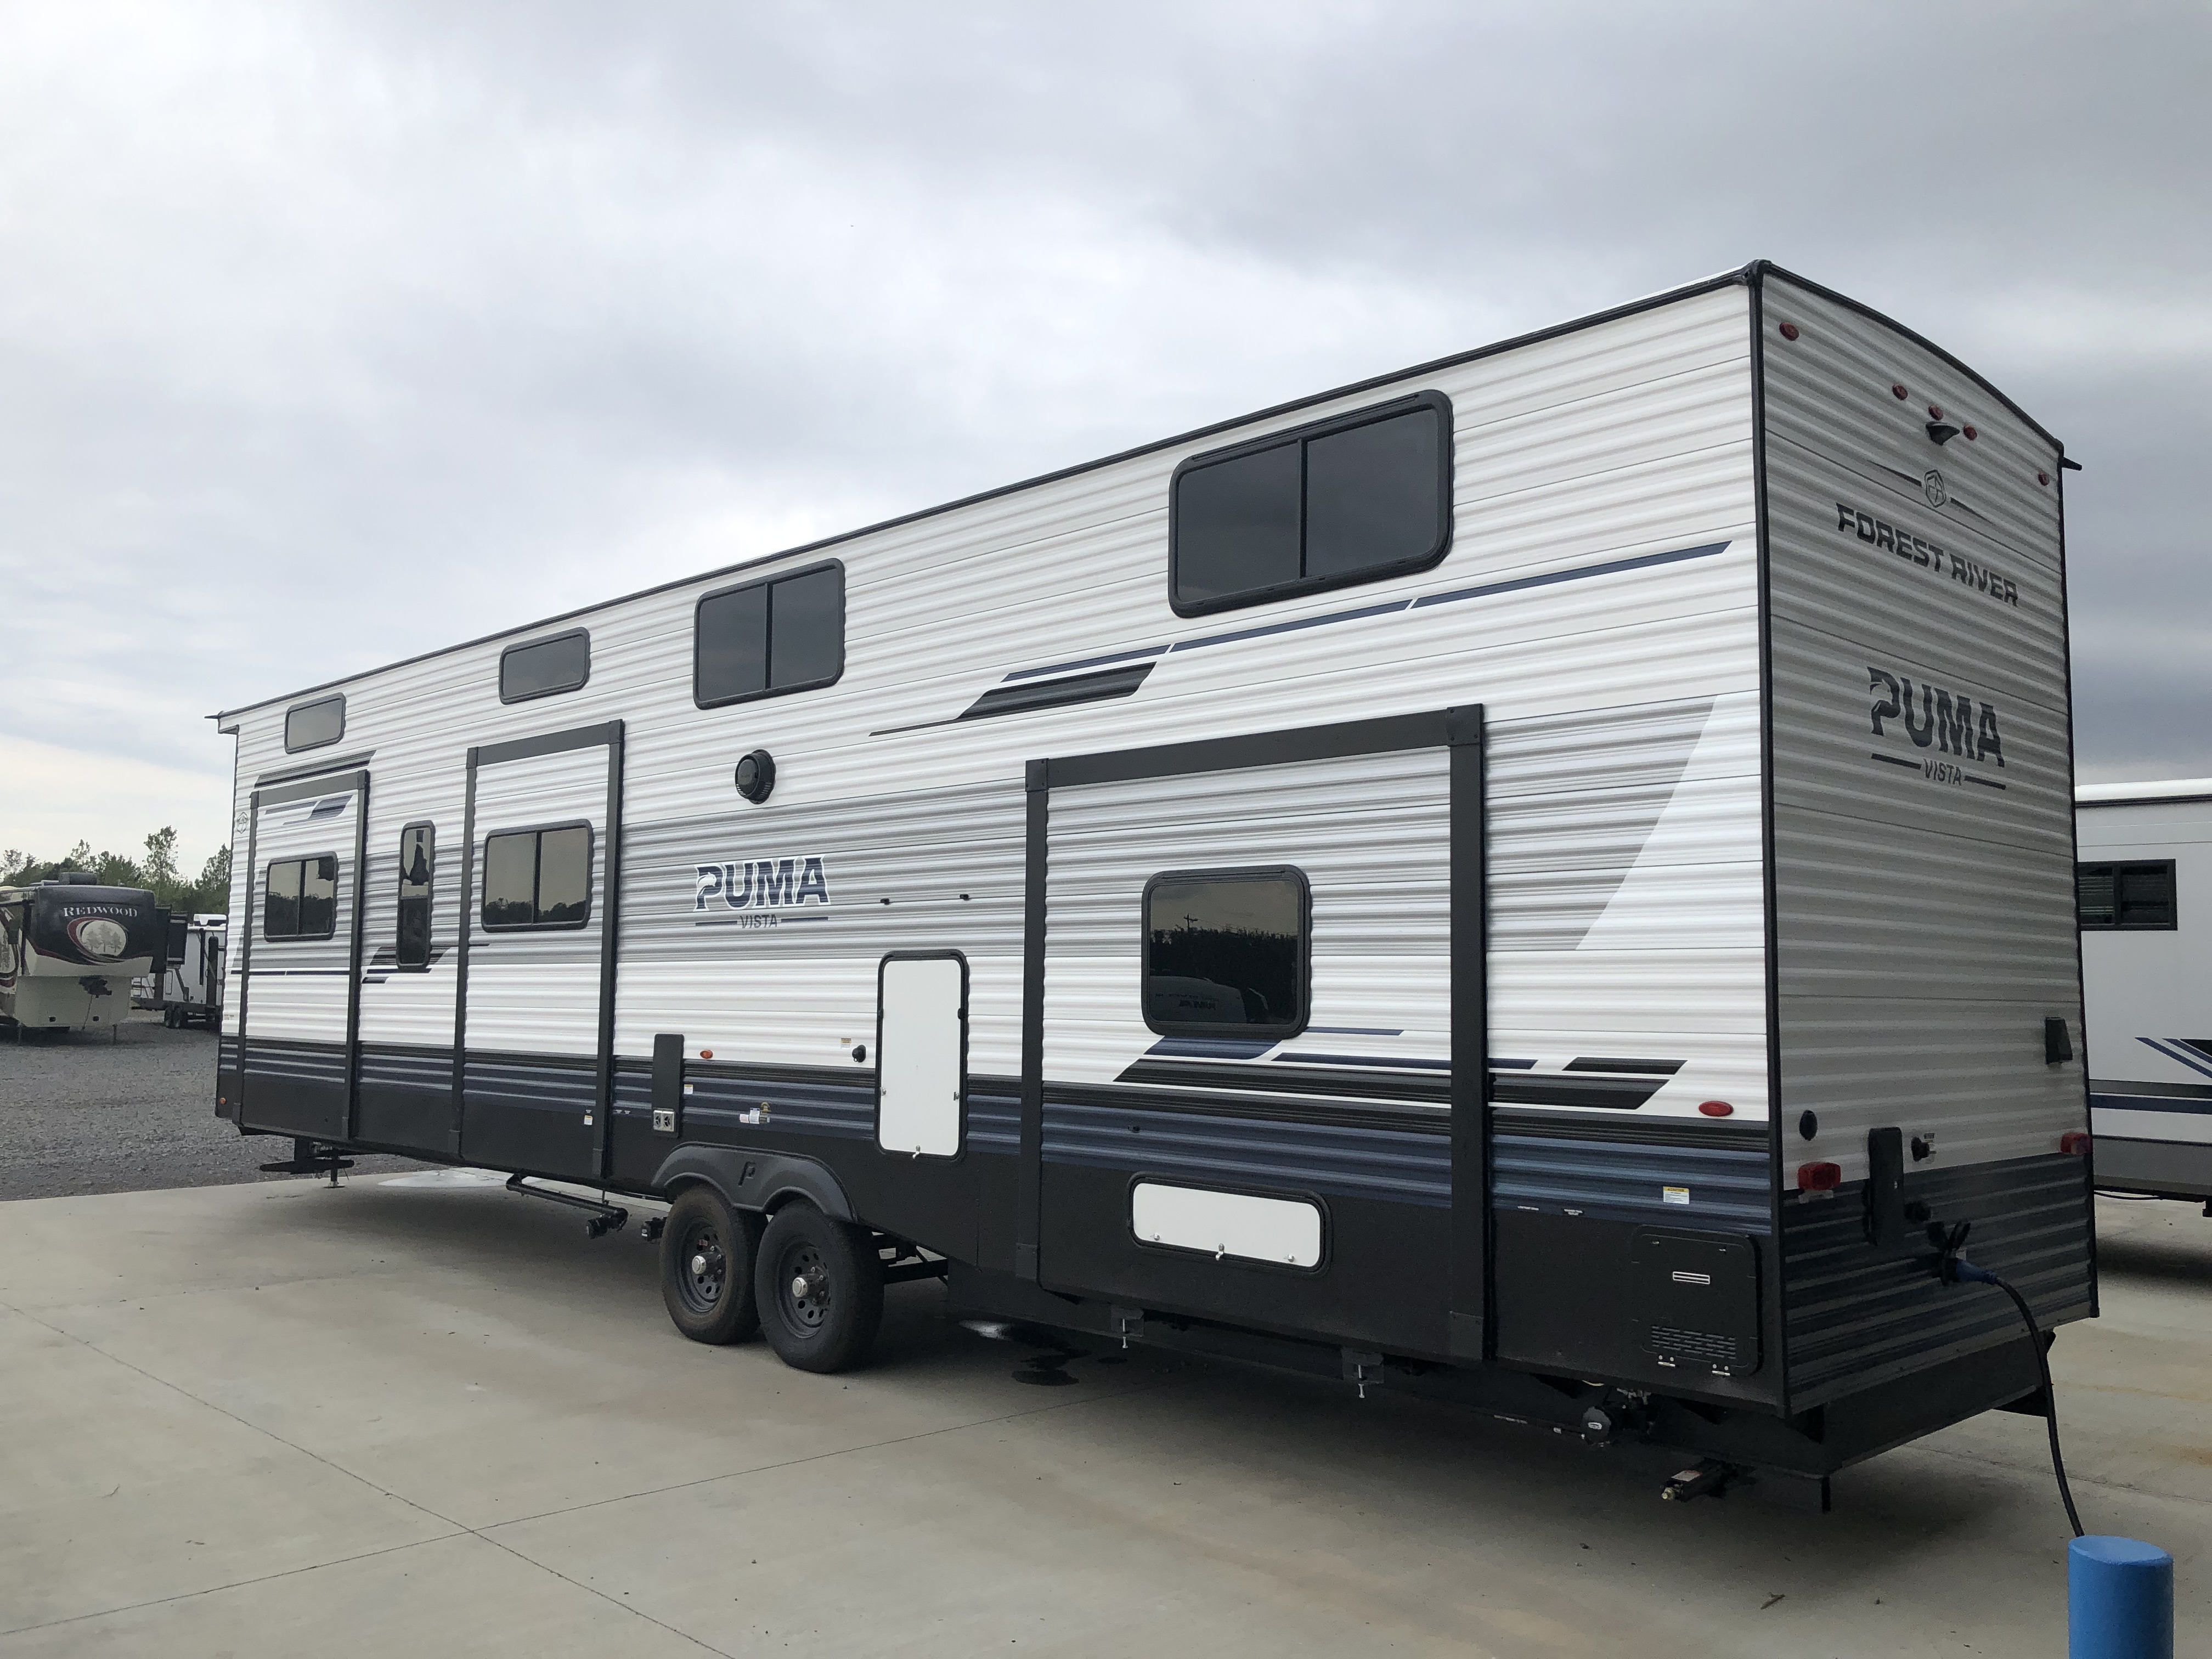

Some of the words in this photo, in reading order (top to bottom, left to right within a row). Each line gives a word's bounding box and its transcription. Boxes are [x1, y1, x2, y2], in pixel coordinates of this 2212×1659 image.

[1836, 502, 1944, 573] FOREST
[1949, 553, 2019, 607] RIVER
[1866, 665, 2005, 768] PUMA
[1923, 758, 1962, 786] VISTA
[693, 854, 831, 912] PUMA
[63, 906, 138, 917] REDWOOD
[739, 913, 778, 929] VISTA
